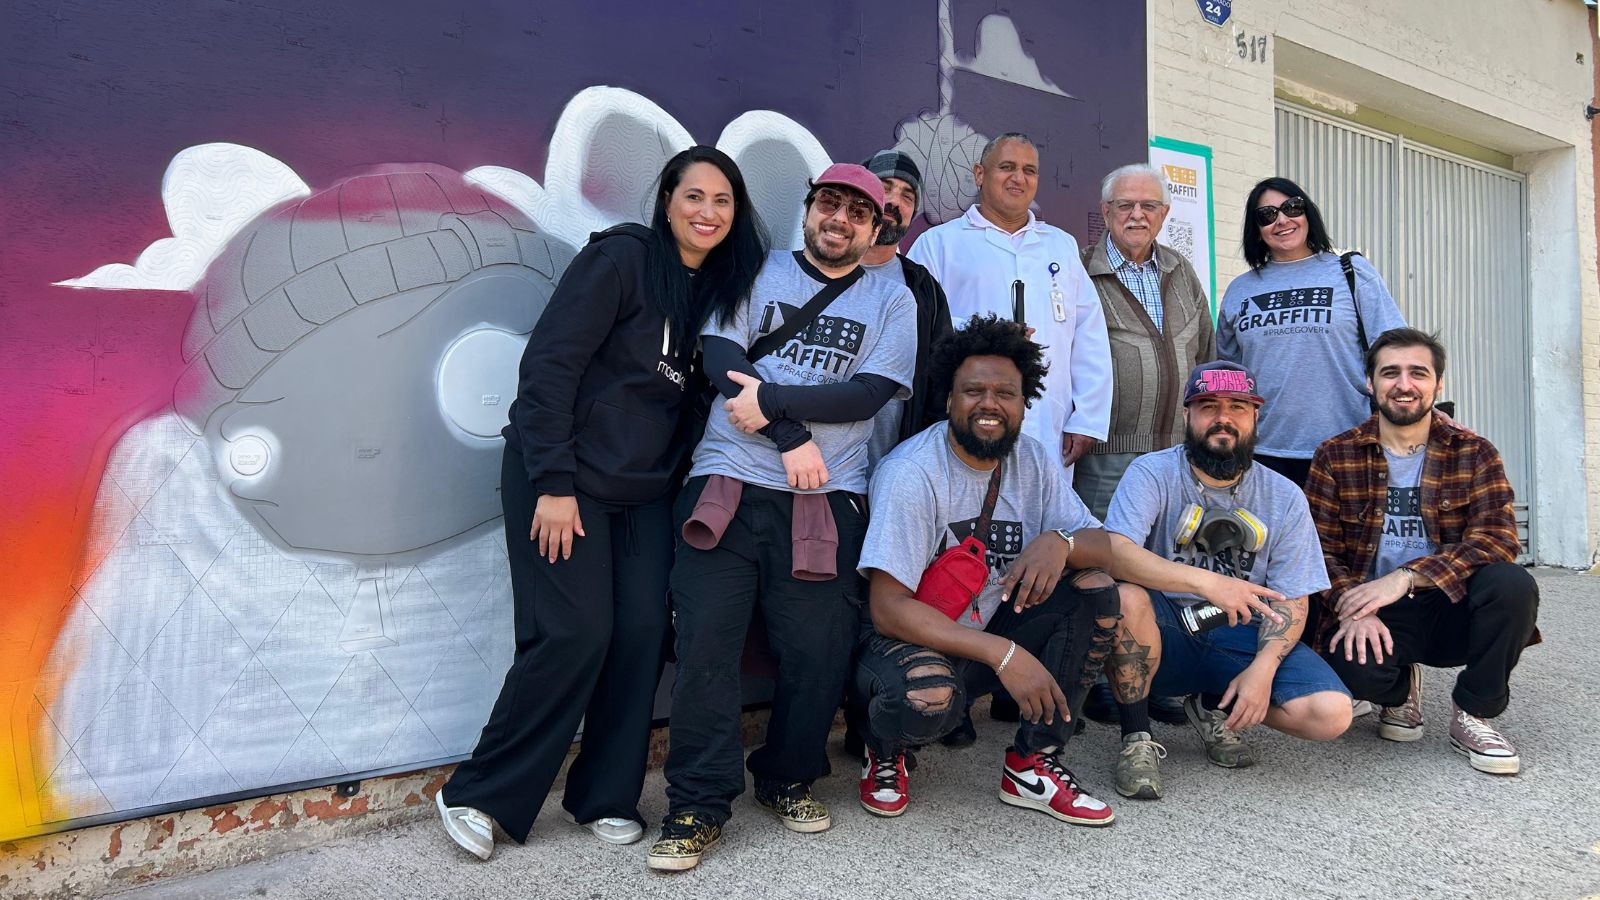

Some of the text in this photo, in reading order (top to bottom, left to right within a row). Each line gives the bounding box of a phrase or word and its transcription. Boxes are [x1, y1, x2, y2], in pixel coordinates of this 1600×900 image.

[1205, 1, 1222, 17] 24
[1235, 30, 1267, 63] 517
[1168, 183, 1197, 198] RAFFITI
[1239, 308, 1332, 332] GRAFFITI
[771, 342, 855, 379] AFFITI
[1385, 518, 1424, 538] AFFI
